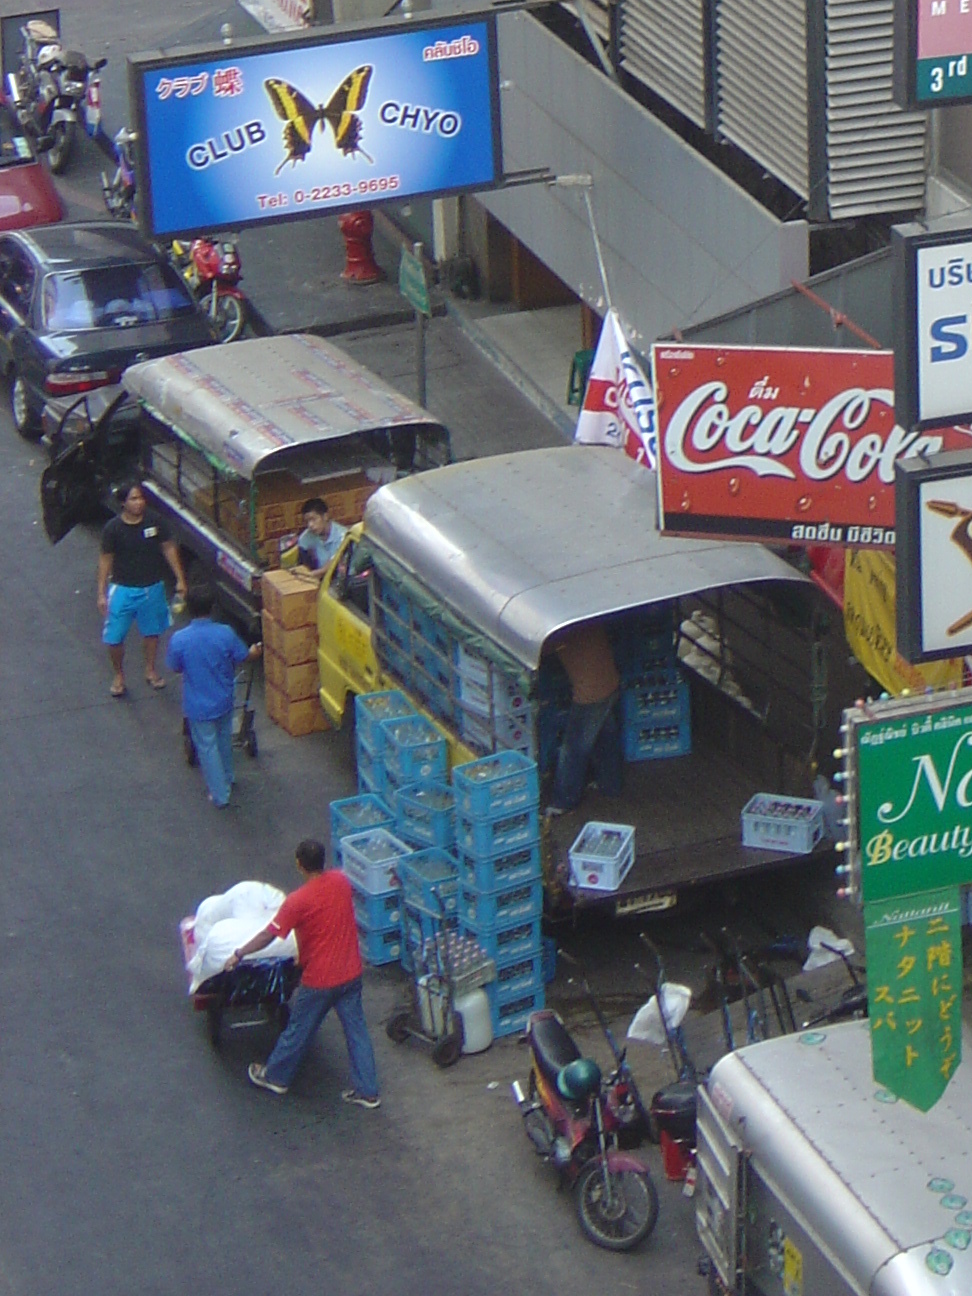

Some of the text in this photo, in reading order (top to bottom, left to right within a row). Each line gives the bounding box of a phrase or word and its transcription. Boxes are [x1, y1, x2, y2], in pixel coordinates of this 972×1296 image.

[156, 68, 243, 100] クラブ 蝶
[187, 101, 459, 170] CLUB CHYO
[258, 176, 400, 209] Tel: 0-2233-9695
[926, 917, 958, 1079] 二階にどうぞ
